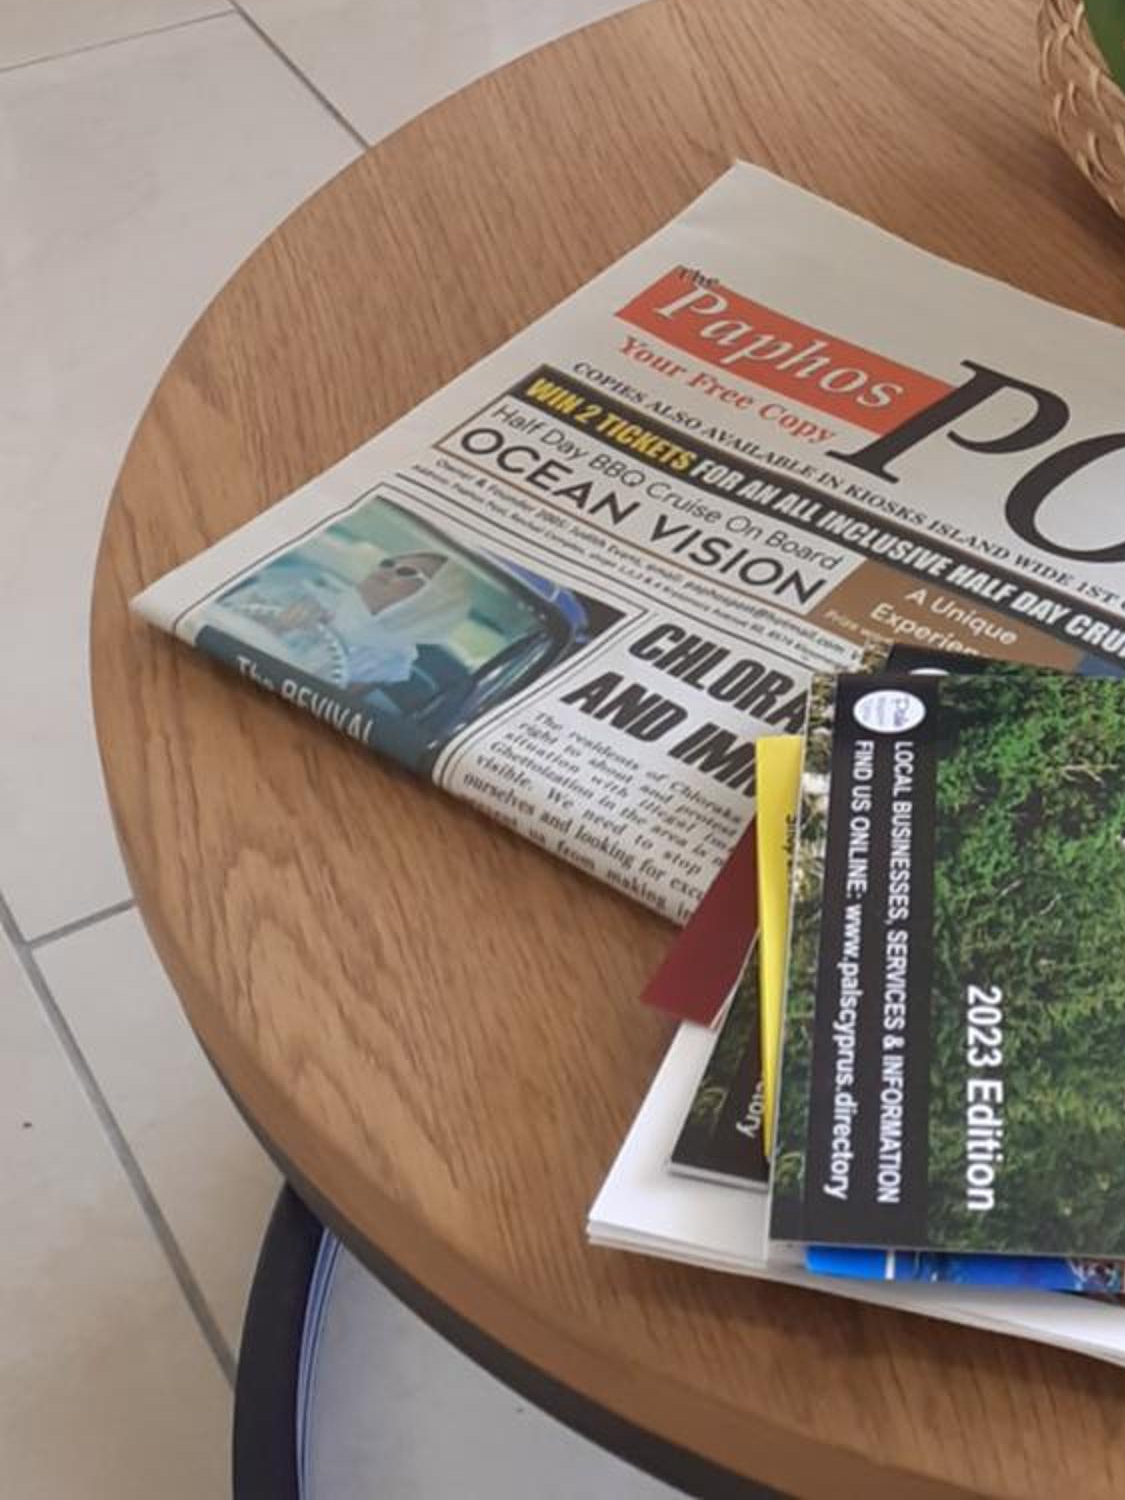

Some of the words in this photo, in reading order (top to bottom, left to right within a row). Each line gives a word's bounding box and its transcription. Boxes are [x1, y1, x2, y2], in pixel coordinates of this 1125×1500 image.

[617, 335, 687, 378] Your
[688, 365, 753, 410] Free
[759, 401, 836, 445] Copy
[653, 284, 905, 410] Paphos
[460, 427, 641, 526] OCEAN
[649, 512, 828, 606] VISION
[491, 403, 548, 436] Half
[539, 427, 588, 461] Day
[588, 453, 646, 488] BBQ
[645, 480, 722, 525] Cruise
[725, 514, 763, 541] On
[764, 529, 845, 571] Board
[526, 376, 585, 415] WIN
[574, 404, 603, 424] 2
[596, 411, 698, 471] TICKETS
[688, 458, 746, 492] FOR
[736, 479, 782, 506] AN
[771, 492, 822, 523] ALL
[815, 510, 954, 579] INCLUSIVE
[945, 561, 1018, 605] HALF
[1010, 589, 1068, 629] DAY
[572, 362, 648, 402] COPIES
[645, 401, 702, 430] ALSO
[702, 424, 819, 478] AVAILABLE
[817, 473, 845, 490] IN
[845, 485, 927, 526] KIOSKS
[927, 518, 1010, 562] ISLAND
[1014, 552, 1075, 587] WIDE
[904, 588, 928, 606] A
[930, 596, 1019, 645] Unique
[560, 670, 688, 743] AND
[546, 788, 575, 810] We
[851, 785, 873, 812] US
[852, 740, 875, 781] FIND
[892, 741, 915, 798] LOCAL
[539, 811, 574, 834] and
[574, 825, 636, 870] looking
[638, 856, 667, 882] for
[845, 816, 871, 900] ONLINE:
[884, 800, 913, 926] BUSINESSES,
[884, 929, 909, 1035] SERVICES
[967, 983, 1003, 1068] 2023
[823, 903, 863, 1201] www.palscyprus.directory
[883, 1035, 905, 1050] &
[877, 1051, 906, 1205] INFORMATION
[966, 1077, 1006, 1212] Edition
